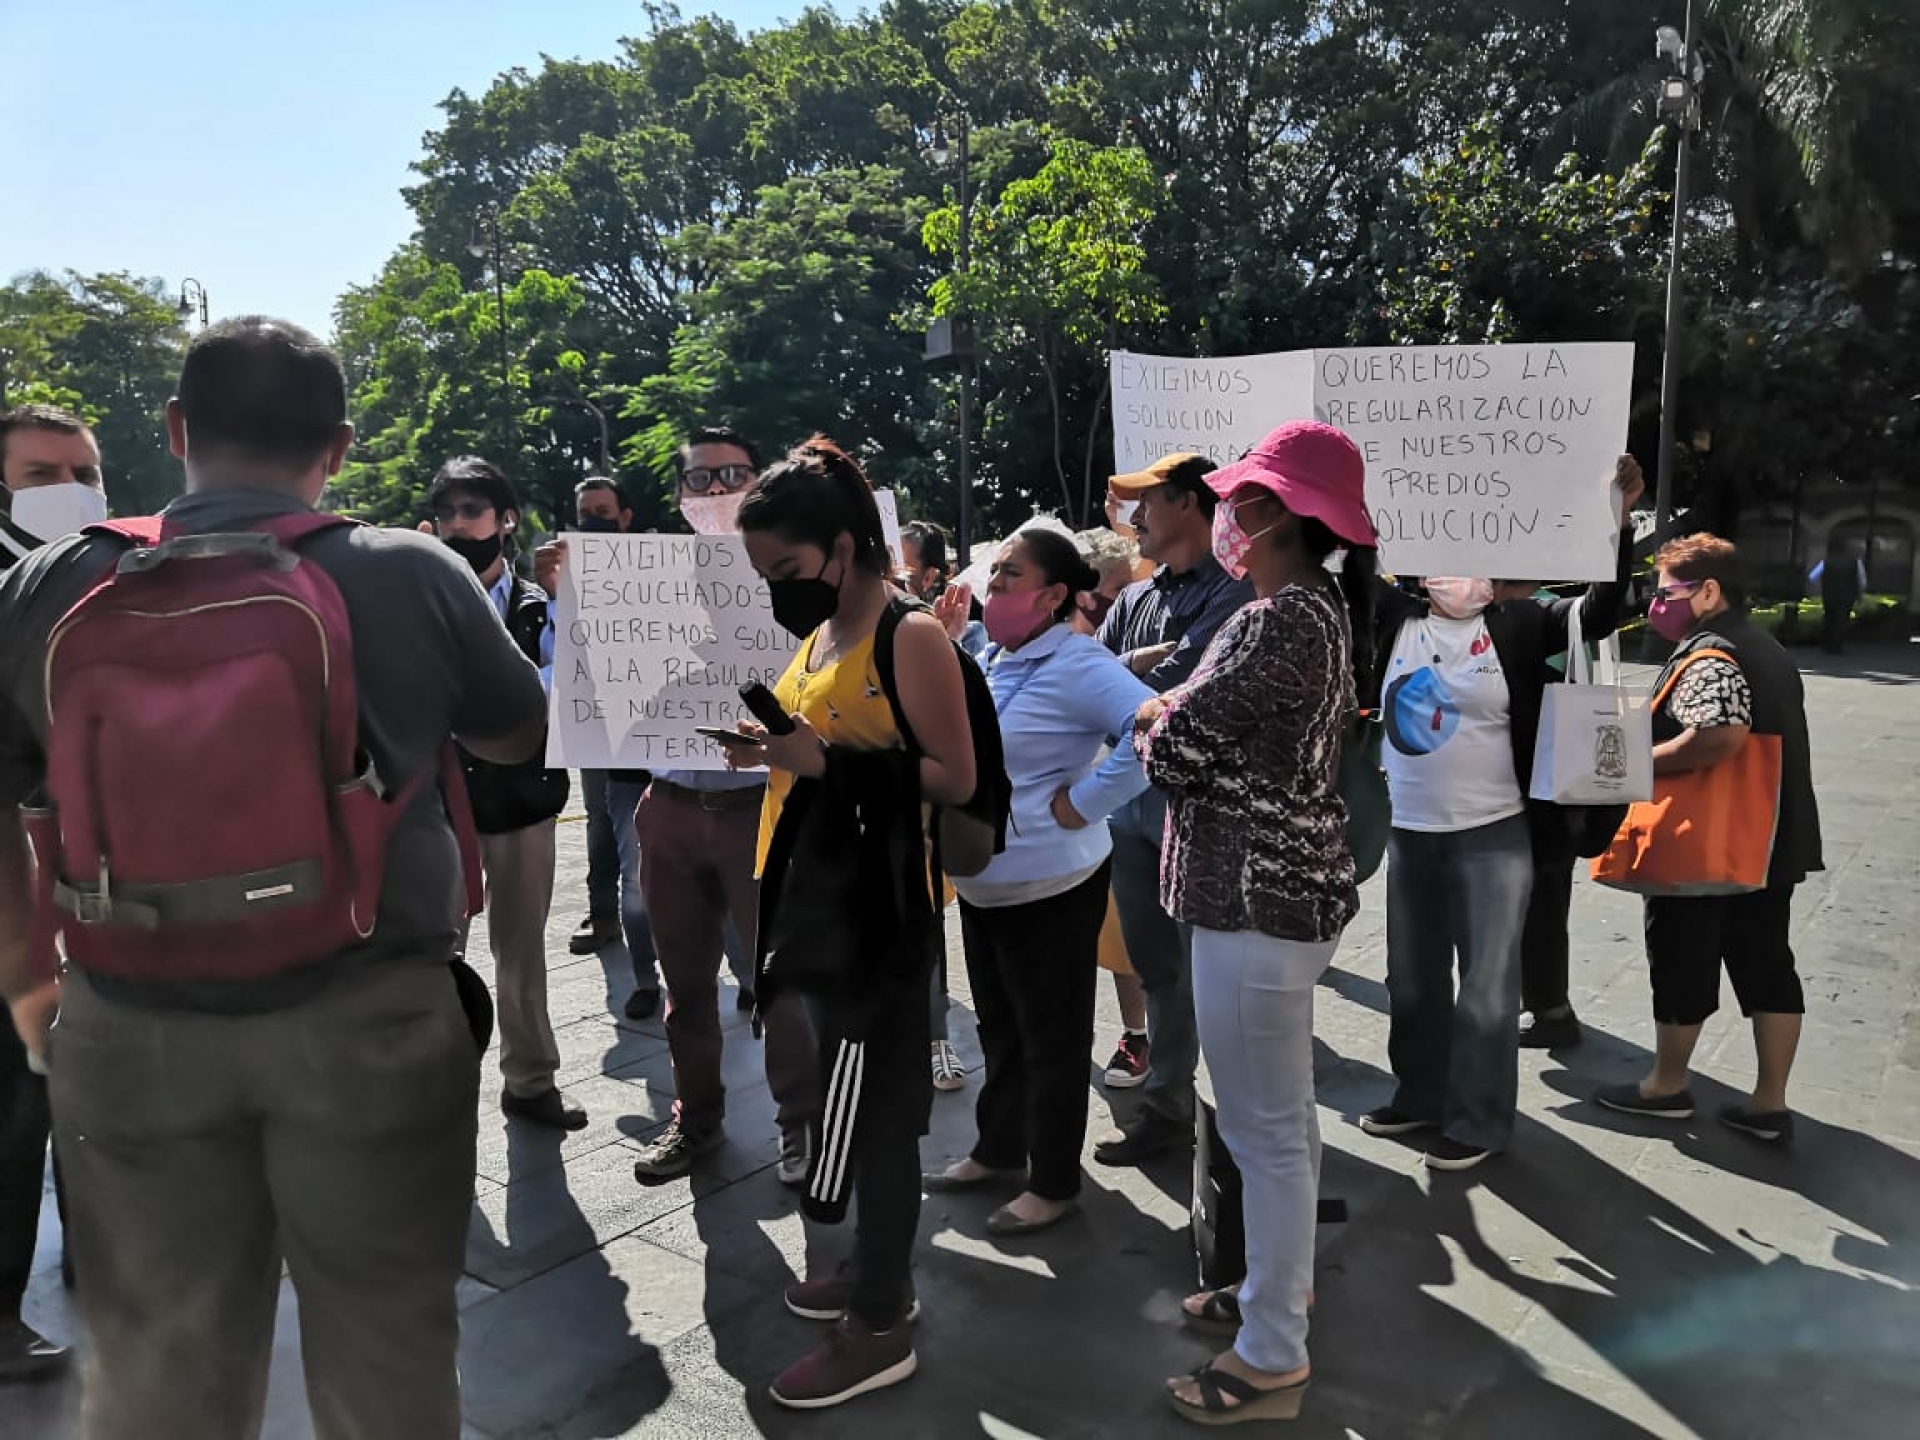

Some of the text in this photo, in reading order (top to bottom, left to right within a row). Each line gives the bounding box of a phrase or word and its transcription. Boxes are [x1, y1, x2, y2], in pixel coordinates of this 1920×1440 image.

[1120, 354, 1253, 394] EXIGIMOS
[1322, 349, 1568, 387] QUEREMOS LA
[1127, 404, 1233, 431] SOLUCION
[1327, 394, 1592, 426] REGULARIZACION
[1364, 430, 1568, 462] E NUESTROS
[1382, 468, 1511, 498] PREDIOS
[1376, 503, 1539, 546] OLUCIÓN
[582, 538, 734, 574] EXIGIMOS
[581, 579, 773, 610] ESCUCHADOS
[569, 617, 799, 652] QUEREMOS SOLU
[573, 656, 777, 688] A LA REGULAR
[573, 699, 606, 723] DE
[632, 734, 718, 760] TERR
